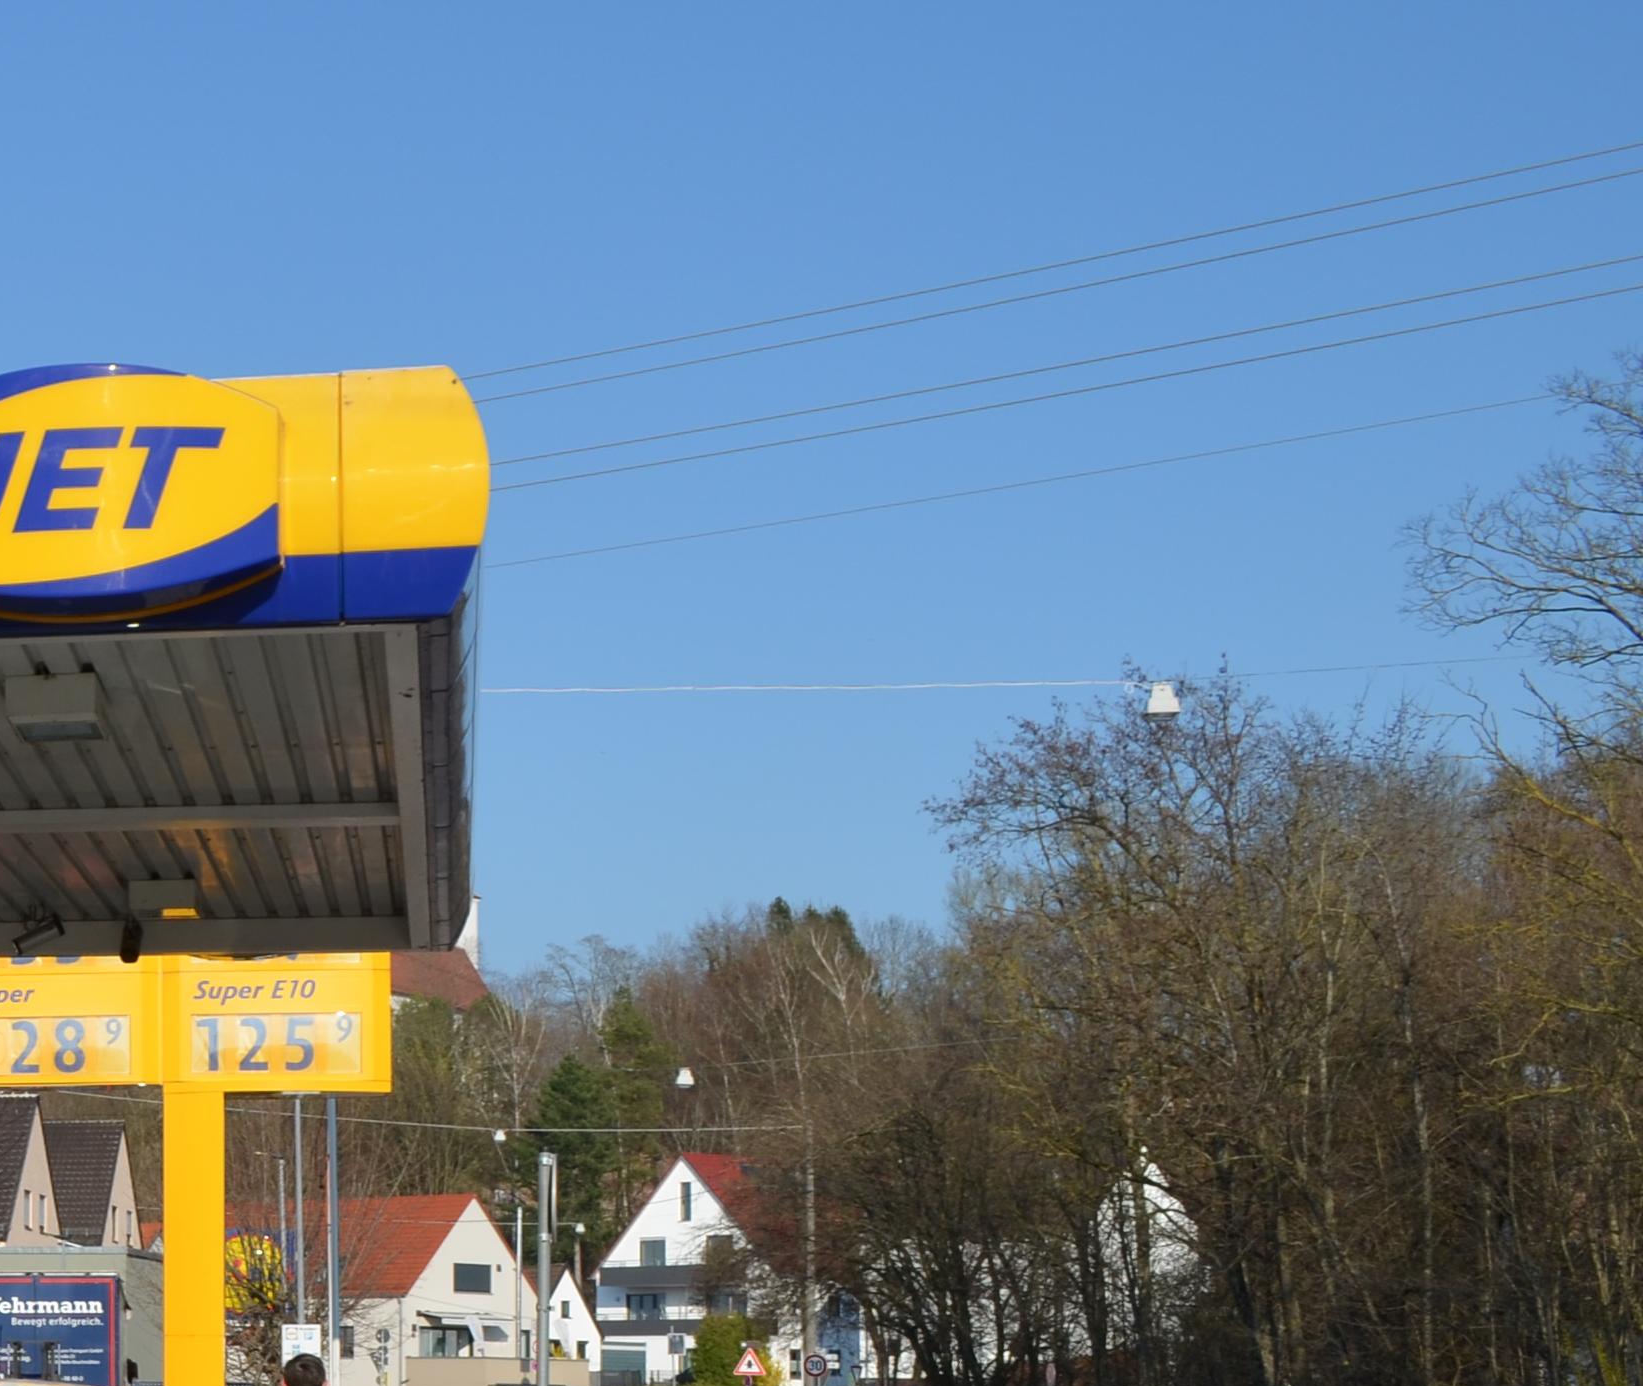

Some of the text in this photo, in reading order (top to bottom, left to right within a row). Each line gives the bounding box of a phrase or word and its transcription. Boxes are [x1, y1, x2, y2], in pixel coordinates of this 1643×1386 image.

[193, 979, 316, 1005] Super E10
[195, 1016, 316, 1071] 125
[11, 1317, 105, 1328] Bewegt erfolgreich.
[807, 1360, 823, 1371] 30
